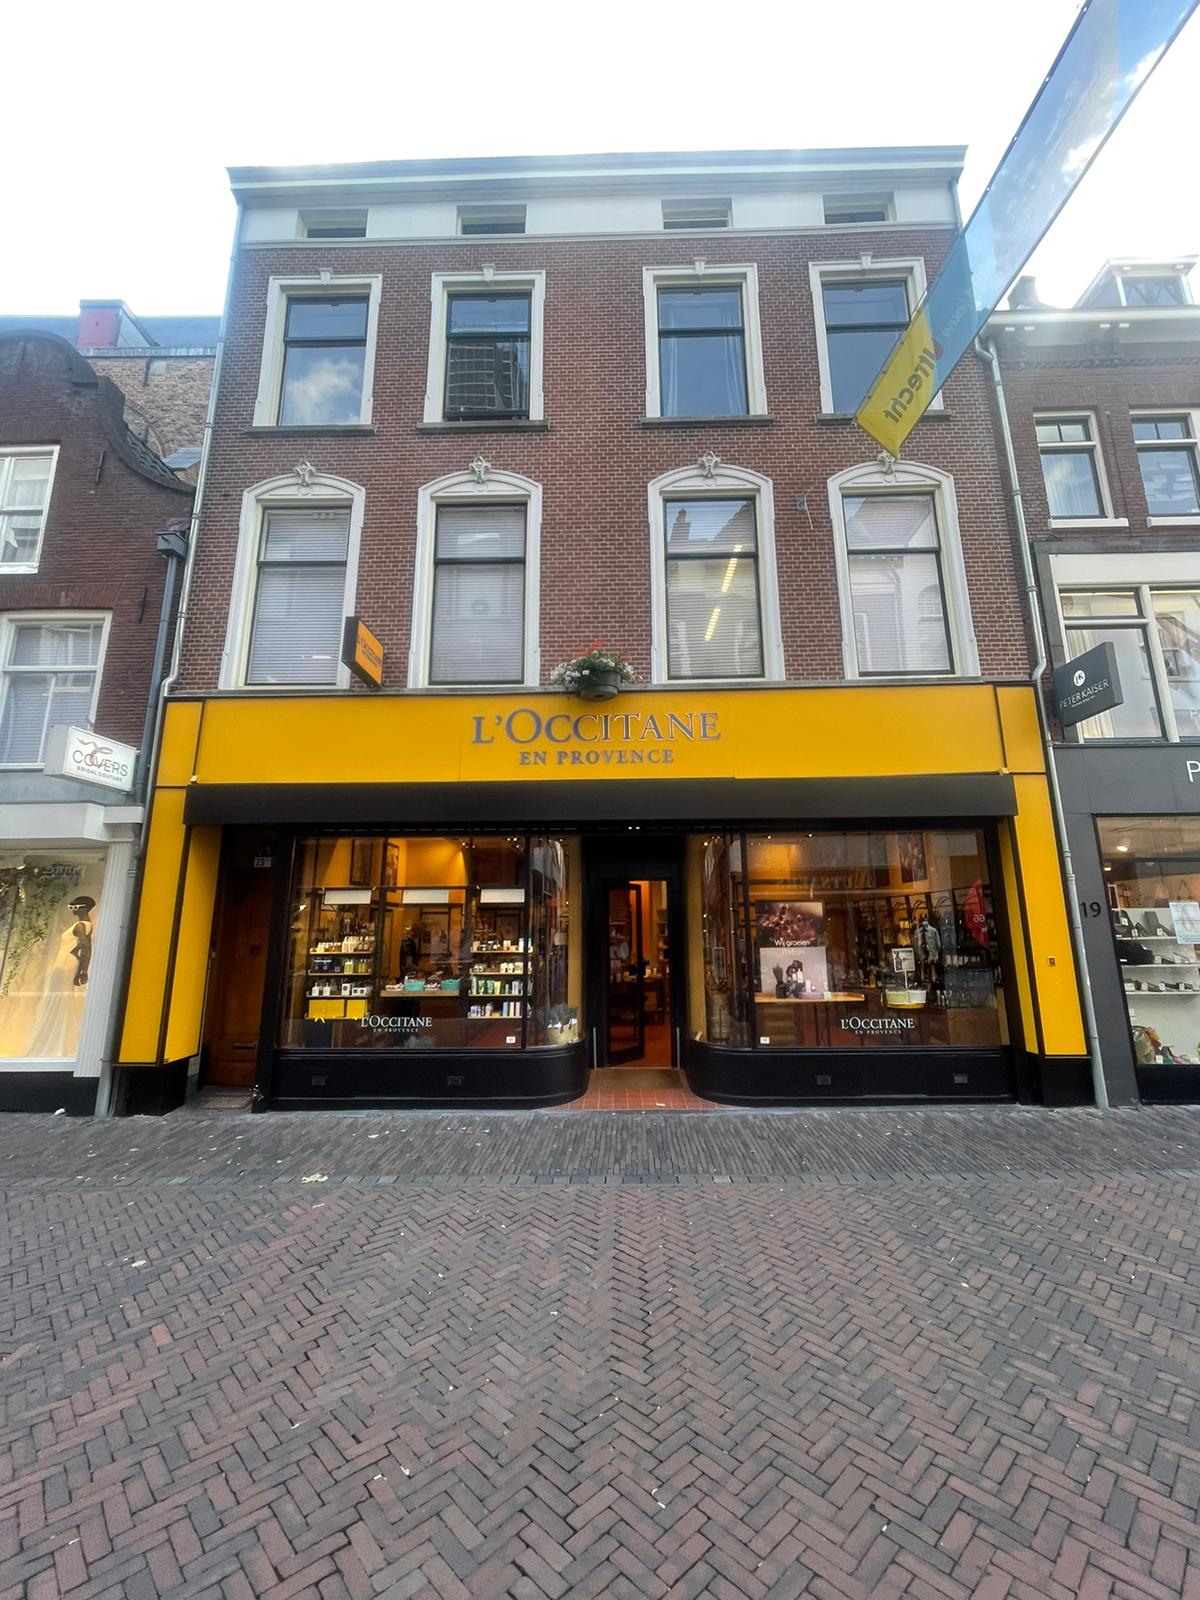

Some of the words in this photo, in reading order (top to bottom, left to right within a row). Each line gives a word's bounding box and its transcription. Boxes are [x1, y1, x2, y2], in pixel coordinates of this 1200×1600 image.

[472, 708, 721, 744] L'OCCITANE
[72, 750, 129, 777] COVERS
[519, 751, 548, 765] EN
[557, 749, 674, 765] PROVENCE
[1080, 901, 1101, 918] 19
[361, 1014, 433, 1028] L'OCCITANE
[841, 1016, 915, 1030] L'OCCITANE
